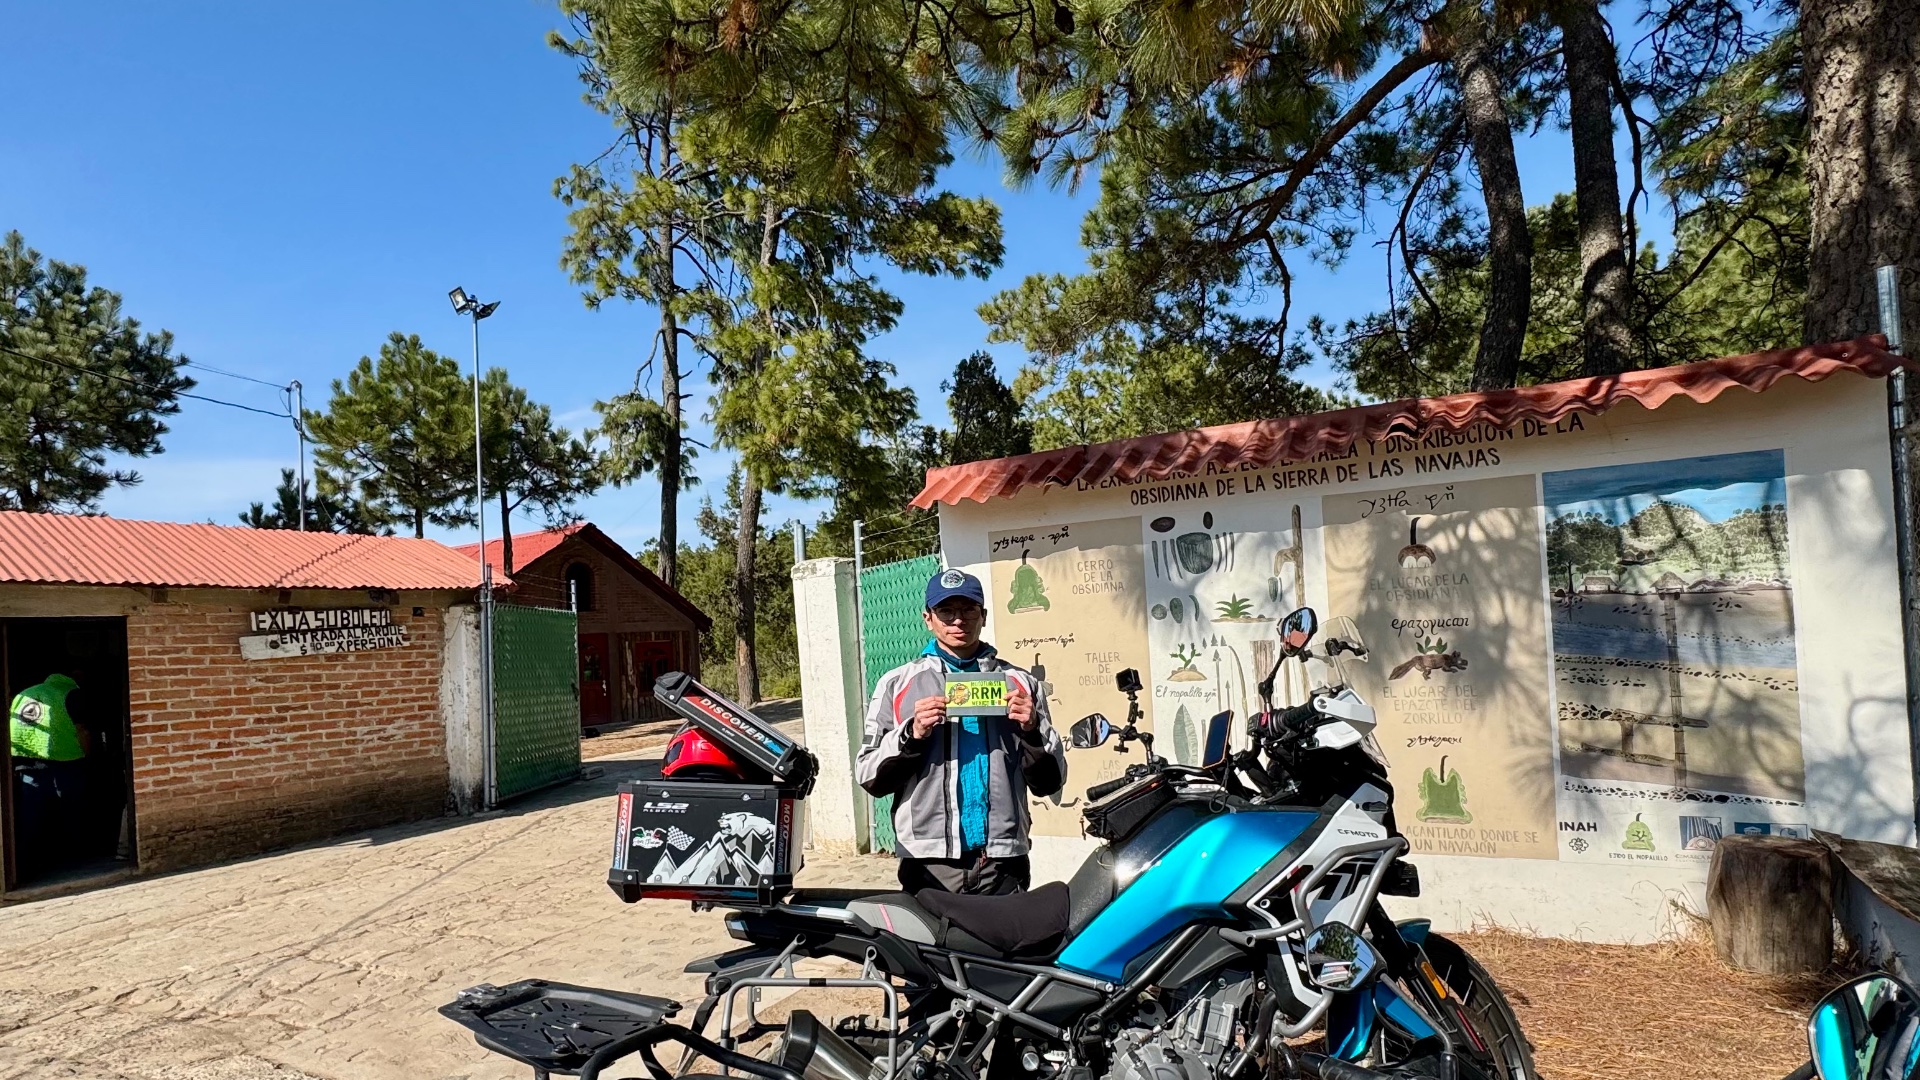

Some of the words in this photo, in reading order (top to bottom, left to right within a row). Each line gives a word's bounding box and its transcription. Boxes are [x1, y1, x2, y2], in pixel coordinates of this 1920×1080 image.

[1366, 439, 1375, 455] Y
[1523, 419, 1548, 437] DE
[1556, 412, 1585, 433] LA
[1131, 481, 1208, 506] OBSIDIANA
[1216, 478, 1235, 497] DE
[1244, 475, 1266, 494] LA
[1272, 468, 1329, 489] SIERRA
[1336, 463, 1359, 483] DE
[1368, 459, 1404, 479] LAS
[1415, 447, 1501, 474] NAVAJAS
[1077, 559, 1113, 572] CERRO
[1084, 571, 1096, 583] DE
[1100, 571, 1113, 581] LA
[1370, 580, 1385, 591] EL
[1392, 575, 1431, 589] LUGAR
[1435, 574, 1448, 585] DE
[1453, 572, 1469, 585] LA
[1072, 581, 1125, 594] OBSIDIANA
[1386, 587, 1460, 602] OBSIDIANA
[257, 610, 310, 631] EXIJA
[280, 629, 345, 645] ENTRADA
[347, 629, 360, 639] AL
[361, 626, 404, 638] PARQUE
[336, 641, 345, 652] X
[346, 637, 403, 653] PERSONA
[1085, 652, 1121, 663] TALLER
[1098, 664, 1111, 673] DE
[1078, 676, 1115, 686] OBSIDIA
[971, 687, 1002, 699] RRM
[1155, 685, 1168, 698] El
[1383, 687, 1397, 698] EL
[1403, 685, 1447, 698] LUGAR
[1455, 685, 1477, 697] DEL
[1394, 698, 1448, 711] EPAZOTE
[1455, 698, 1476, 710] DEL
[700, 698, 772, 747] DISCOVERY
[1403, 713, 1462, 724] ZORRILLO
[620, 798, 628, 835] MOTO
[1559, 821, 1597, 832] INAH
[1337, 828, 1379, 839] CFMOTO
[1405, 825, 1476, 841] ACANTILADO
[1481, 829, 1519, 842] DONDE
[1524, 831, 1540, 844] SE
[1414, 839, 1433, 851] UN
